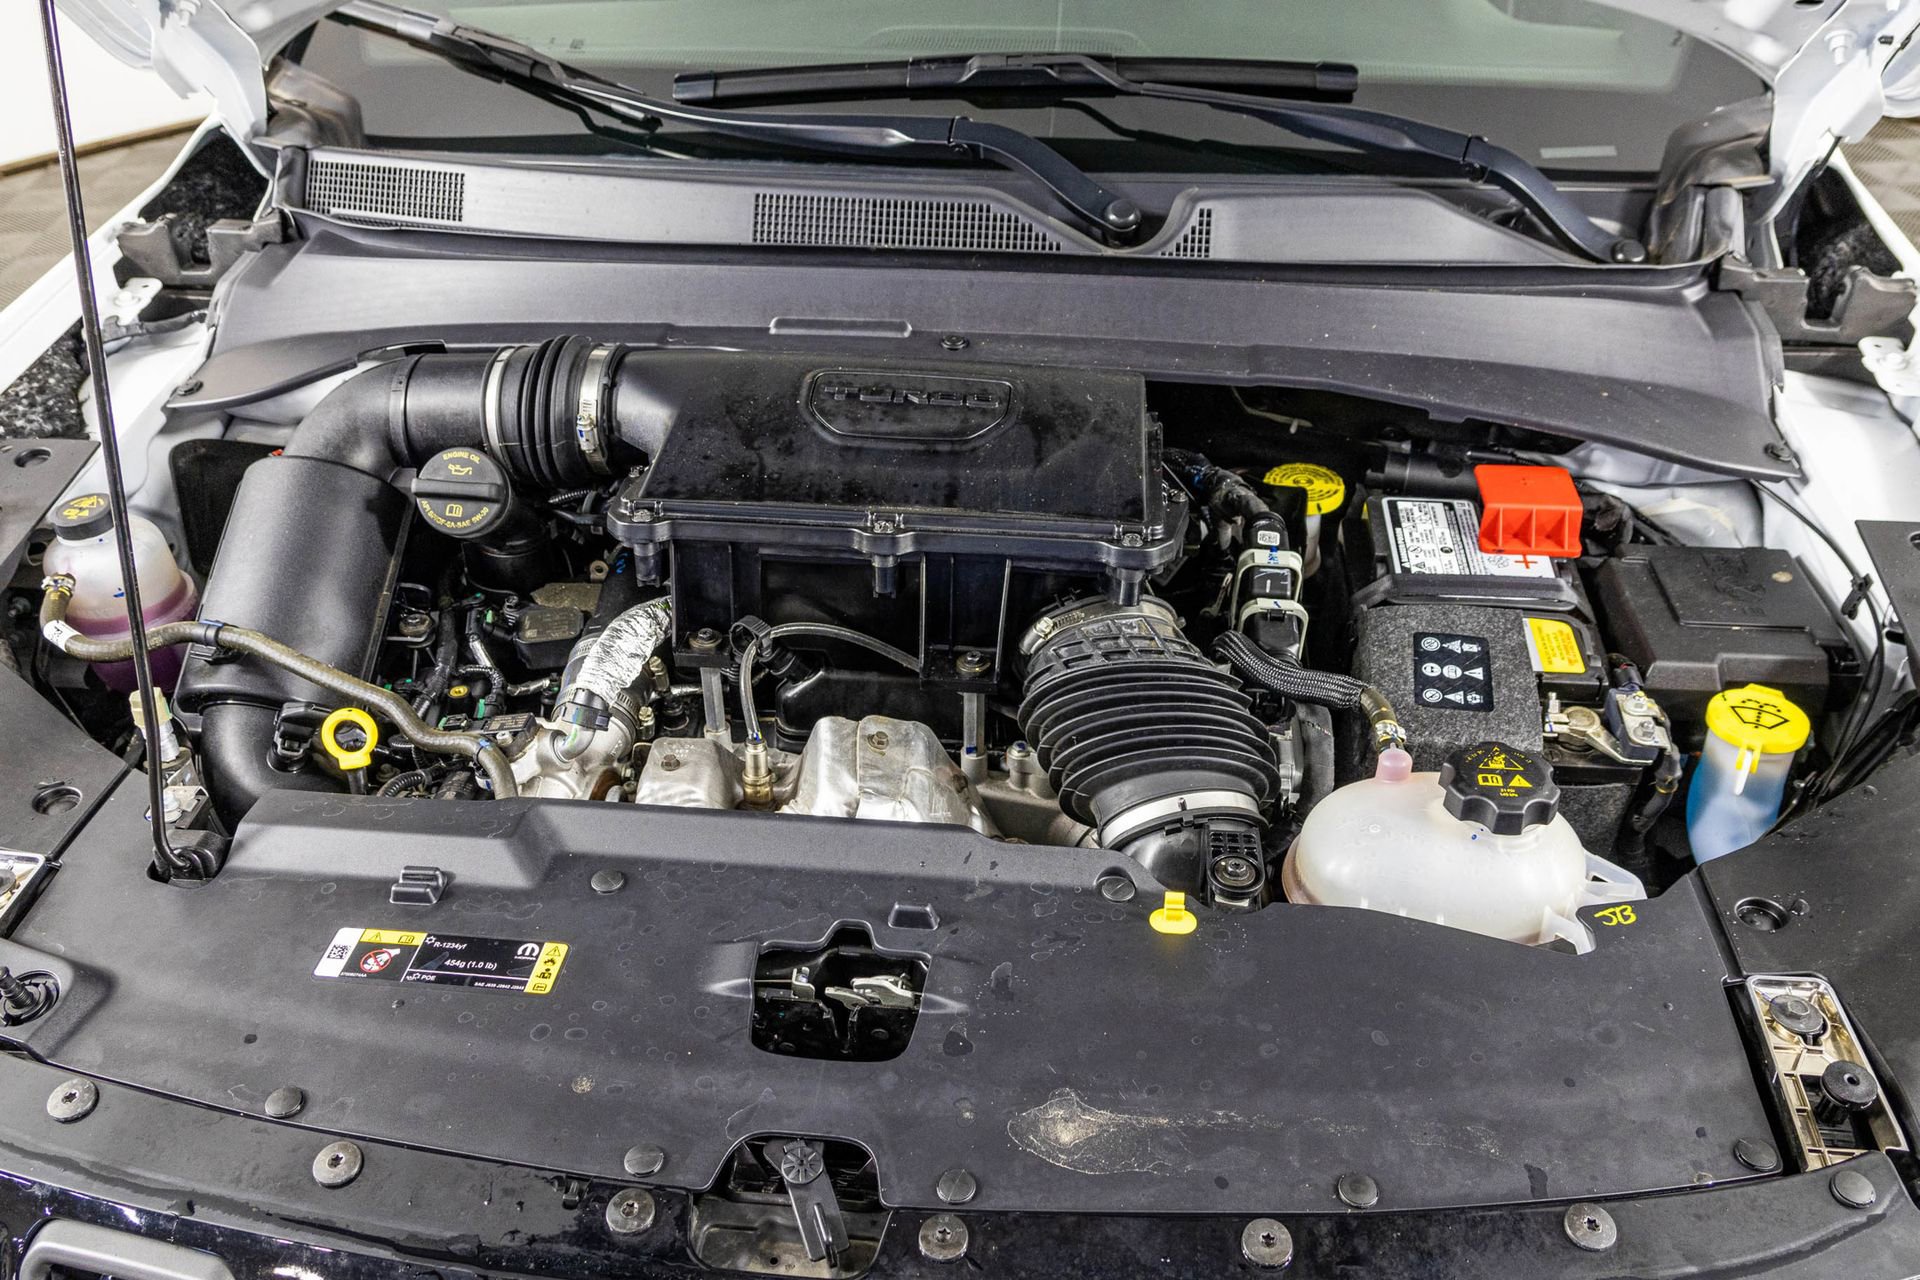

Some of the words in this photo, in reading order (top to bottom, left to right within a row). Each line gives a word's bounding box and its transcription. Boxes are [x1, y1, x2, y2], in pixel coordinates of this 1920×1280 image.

[442, 451, 469, 461] ENGINE
[469, 454, 481, 464] OIL
[1593, 904, 1637, 926] JB
[433, 941, 468, 951] R-1234yf
[444, 959, 465, 969] 454g
[466, 960, 484, 969] (1.0
[484, 962, 498, 971] lb)
